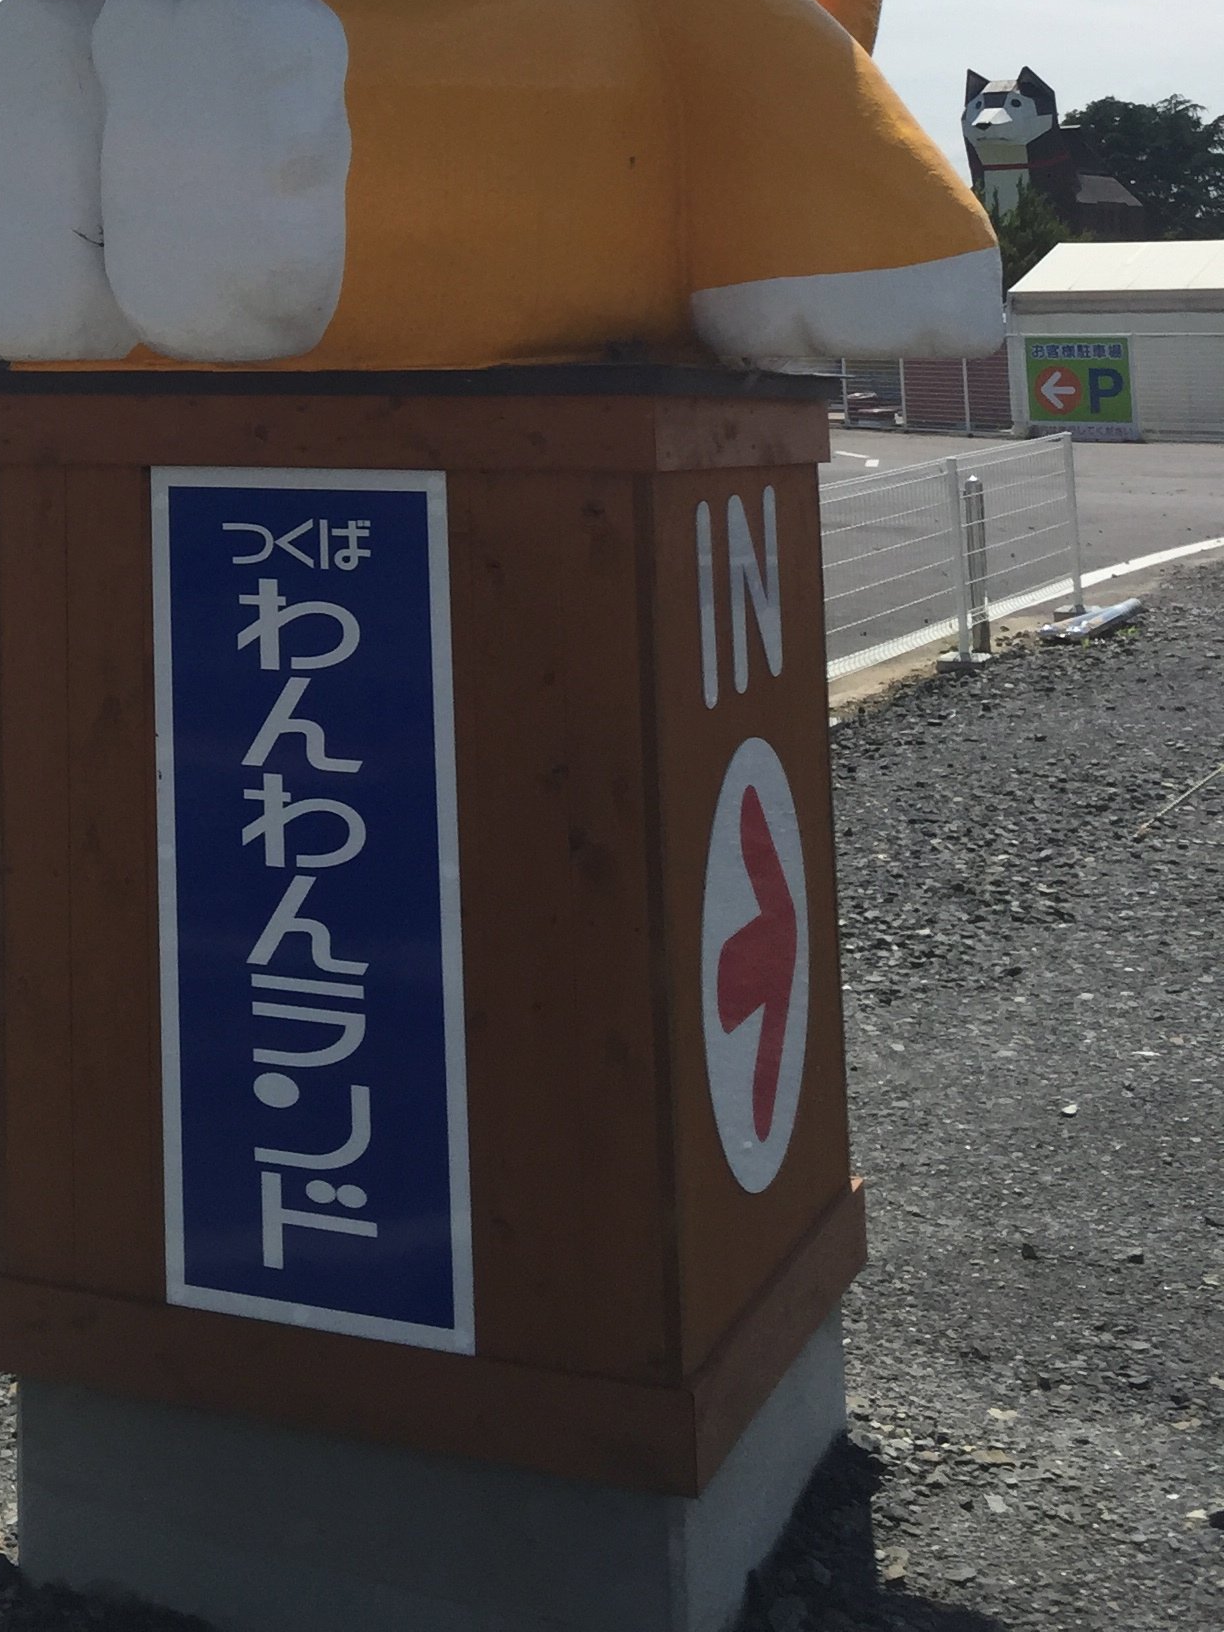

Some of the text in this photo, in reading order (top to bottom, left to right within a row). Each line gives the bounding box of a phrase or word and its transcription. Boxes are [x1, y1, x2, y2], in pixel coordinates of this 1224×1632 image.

[1031, 343, 1122, 359] お客様駐車場
[1088, 367, 1124, 414] P
[222, 518, 372, 571] つくば
[696, 485, 784, 709] IN
[236, 577, 378, 1270] わんわんランド
